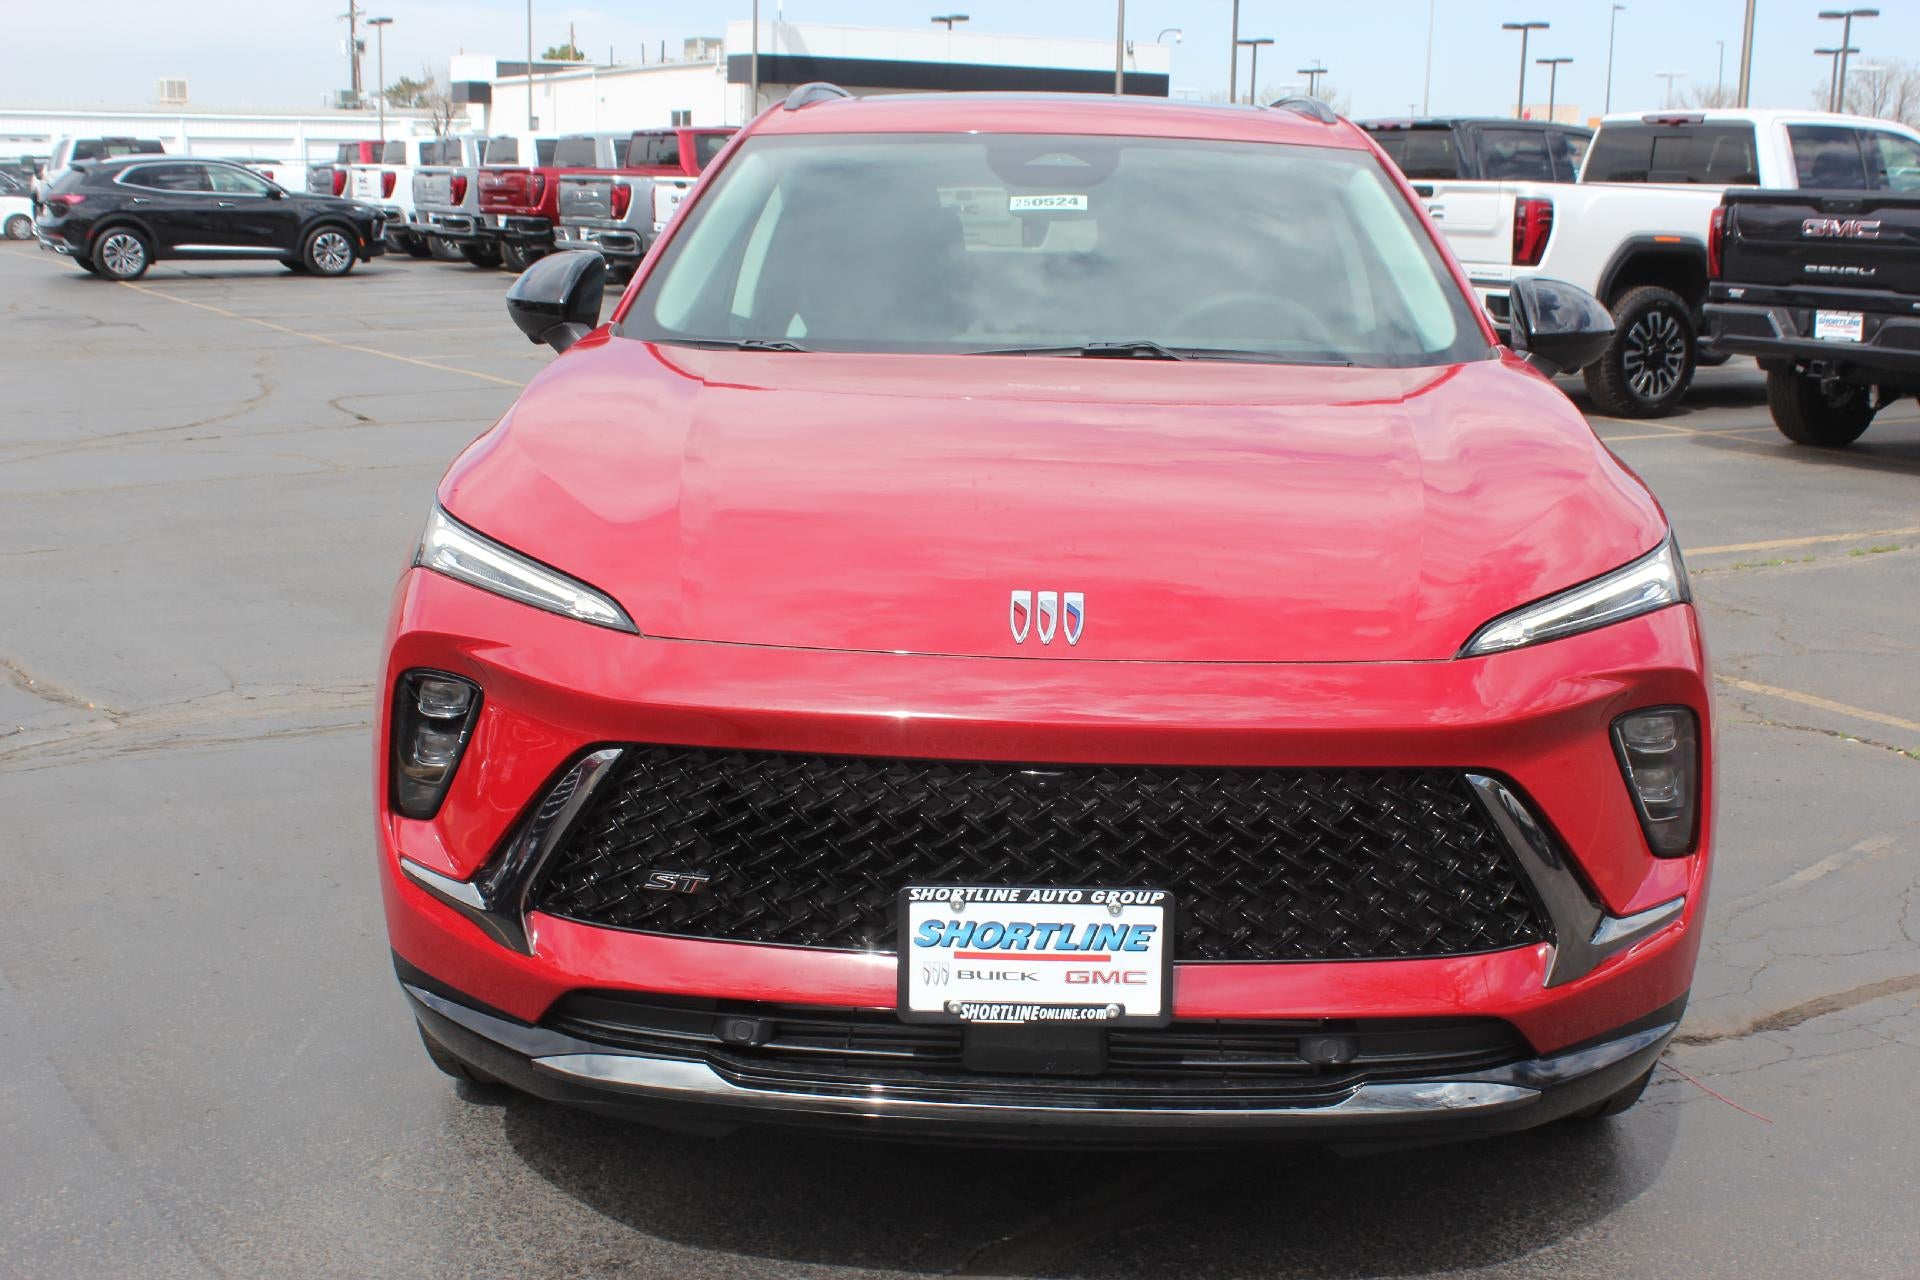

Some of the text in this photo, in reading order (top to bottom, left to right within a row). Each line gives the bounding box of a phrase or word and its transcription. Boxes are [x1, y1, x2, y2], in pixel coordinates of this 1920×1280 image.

[1803, 217, 1881, 239] GMC
[1804, 264, 1876, 276] DENALI
[644, 870, 710, 893] ST
[909, 888, 1165, 905] SHORTLINE AUTO GROUP
[913, 919, 1157, 951] SHORTLINE
[957, 970, 1040, 982] BUICK
[1064, 970, 1148, 985] GMC
